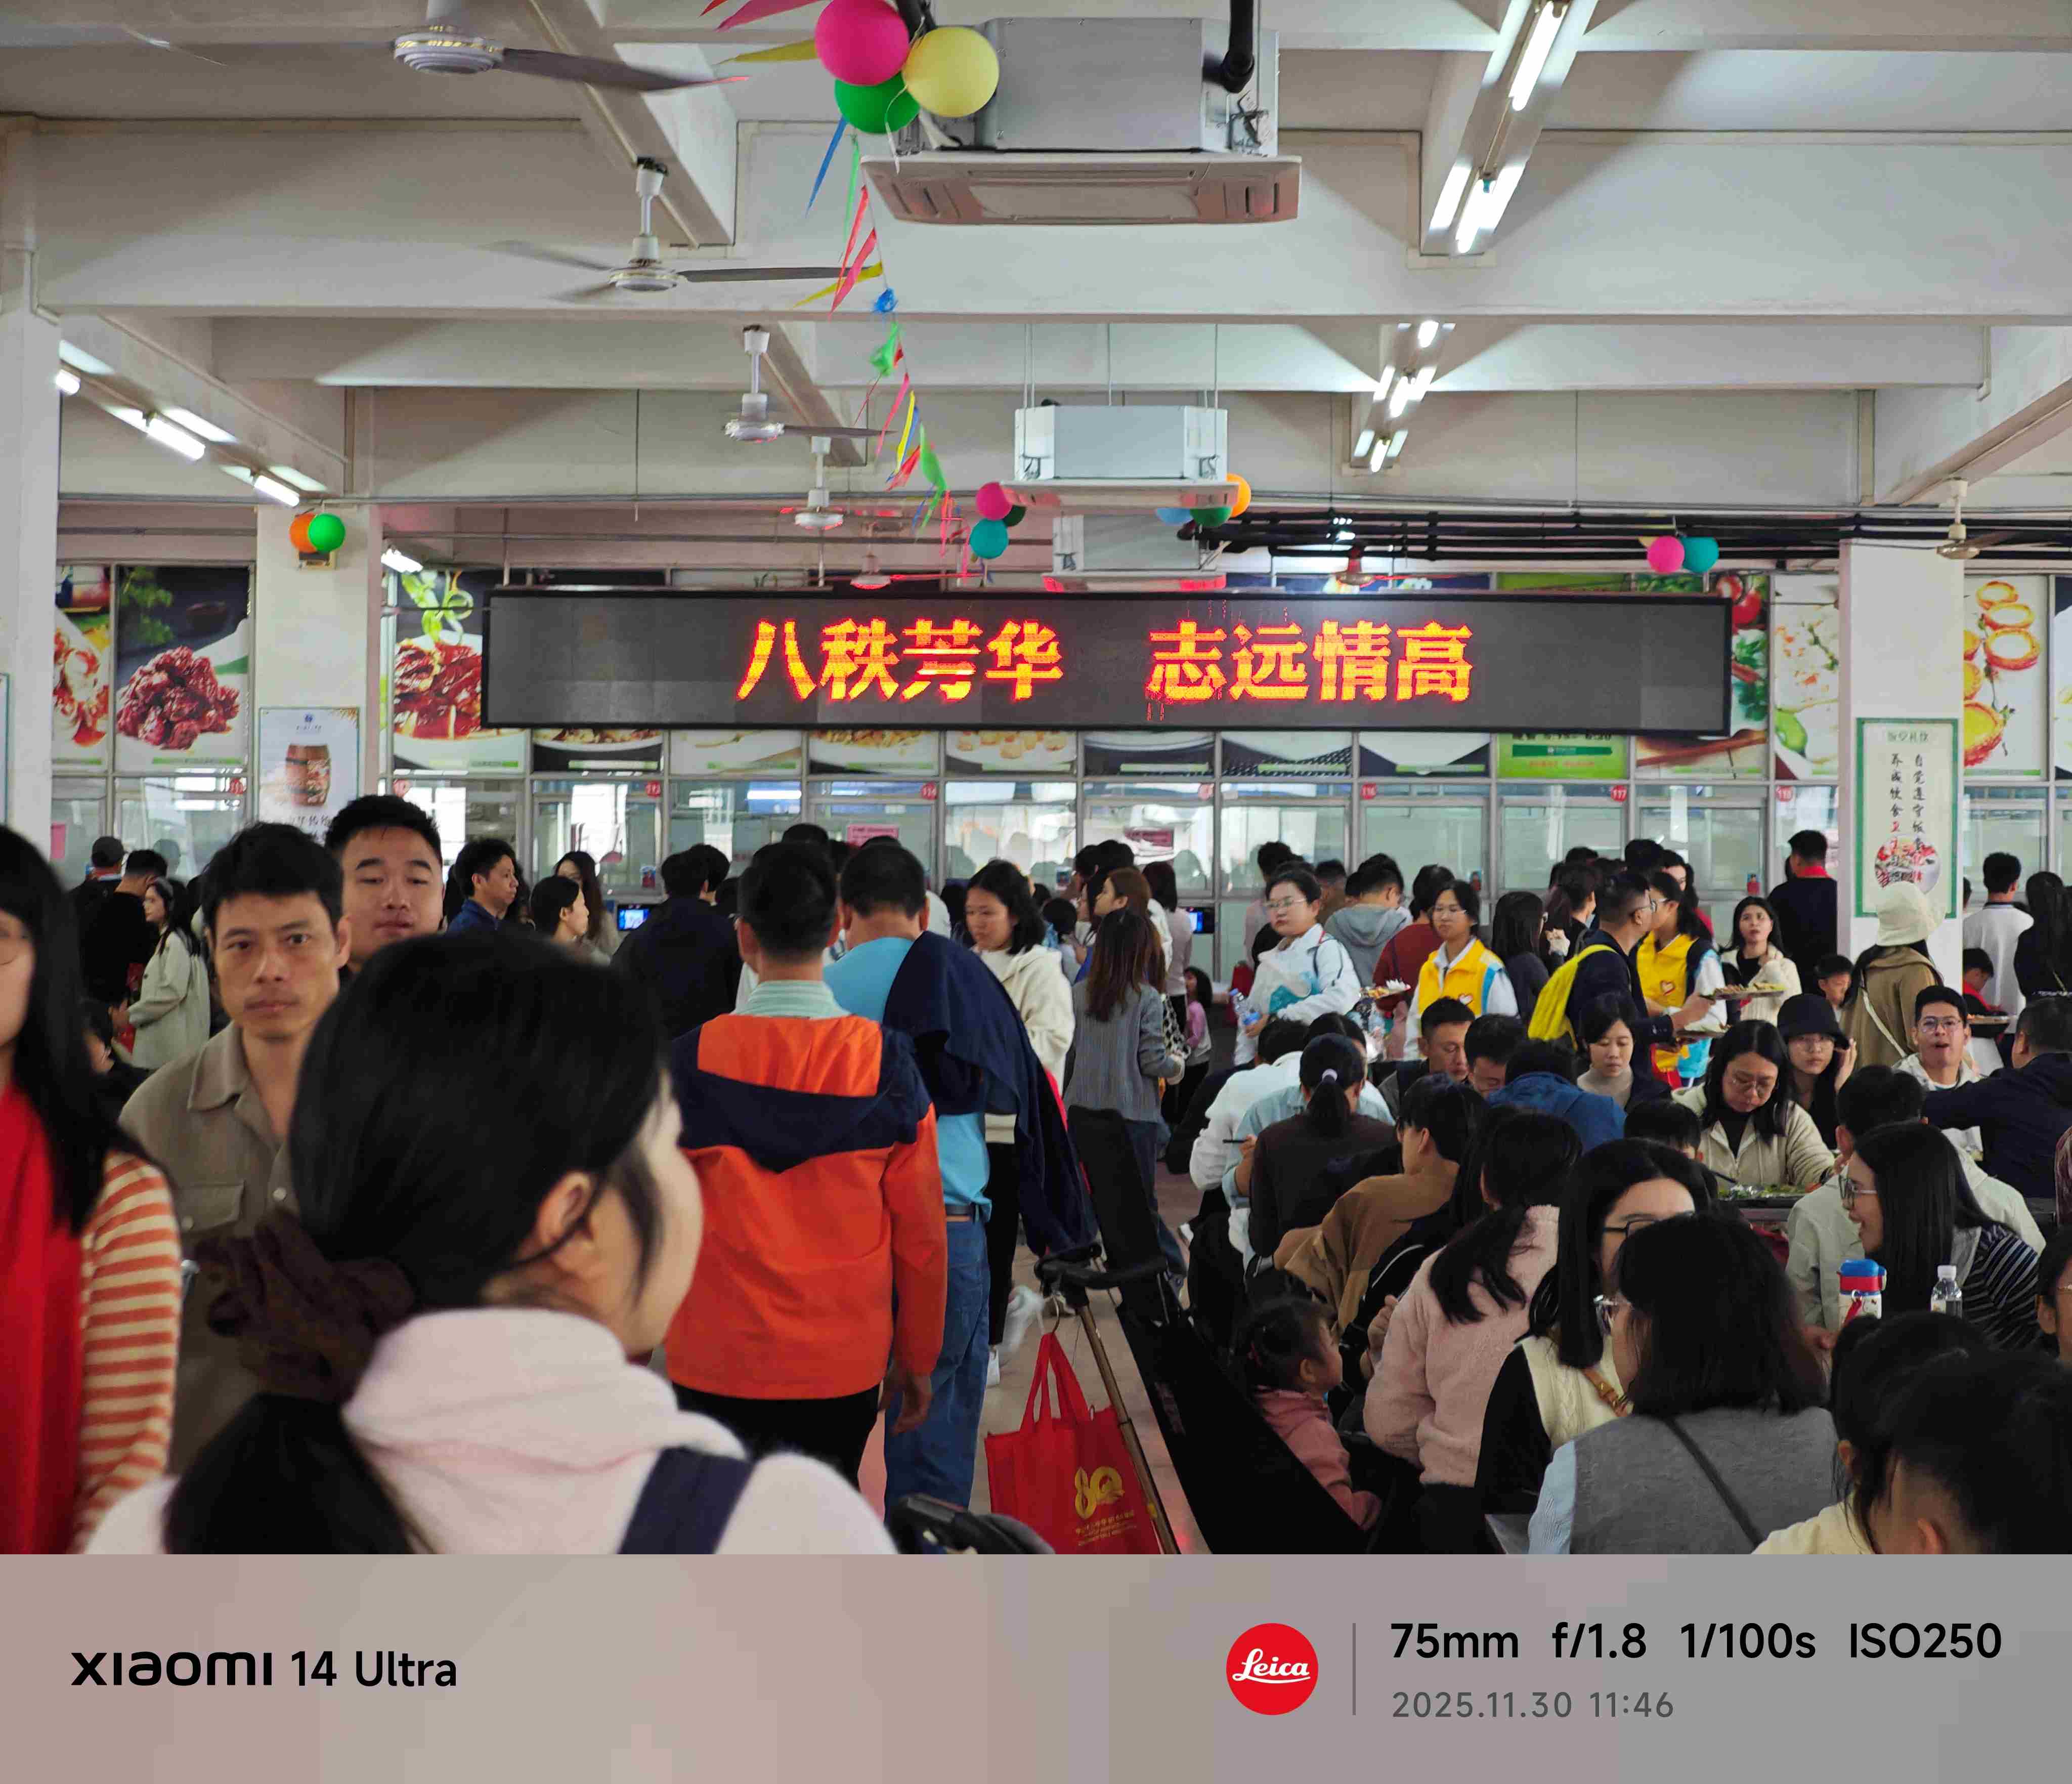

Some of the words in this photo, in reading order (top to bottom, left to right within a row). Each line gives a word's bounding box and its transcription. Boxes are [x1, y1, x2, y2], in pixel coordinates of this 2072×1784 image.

[736, 618, 1064, 701] 八秩芳华
[1146, 619, 1473, 702] 志远情高
